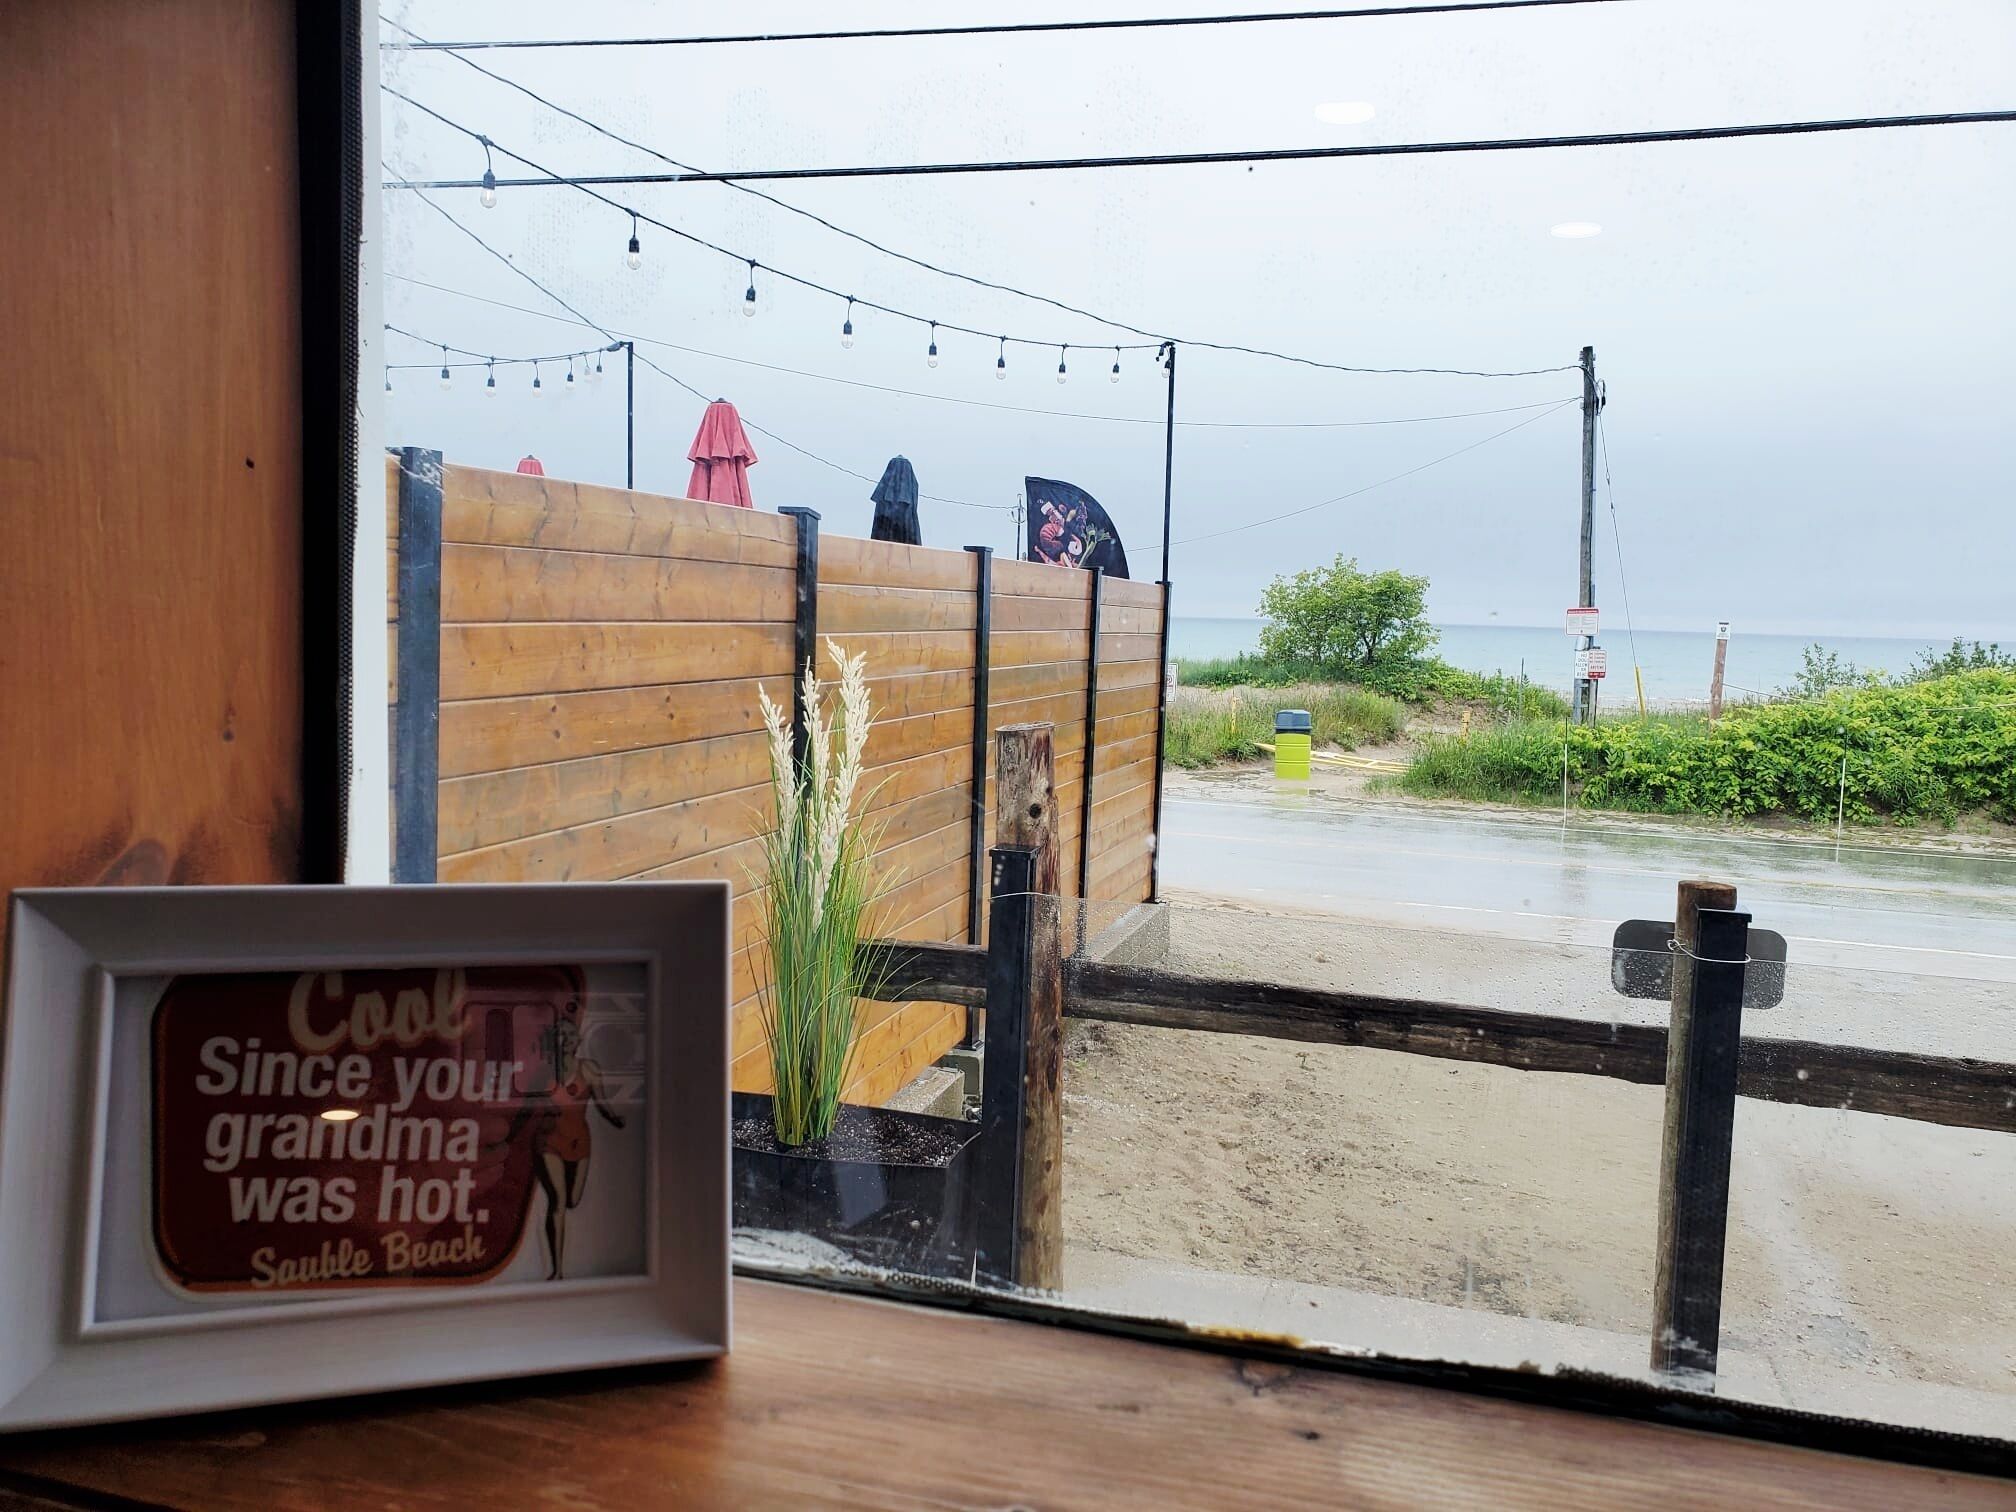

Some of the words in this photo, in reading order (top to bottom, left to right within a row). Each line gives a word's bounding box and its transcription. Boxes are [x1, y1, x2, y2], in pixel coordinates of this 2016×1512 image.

[289, 968, 468, 1051] Cool
[195, 1035, 372, 1099] Since
[393, 1054, 523, 1112] your
[202, 1104, 479, 1172] grandma
[228, 1176, 356, 1223] was
[377, 1166, 490, 1223] hot.
[250, 1238, 374, 1288] Sauble
[381, 1223, 487, 1271] Beach
